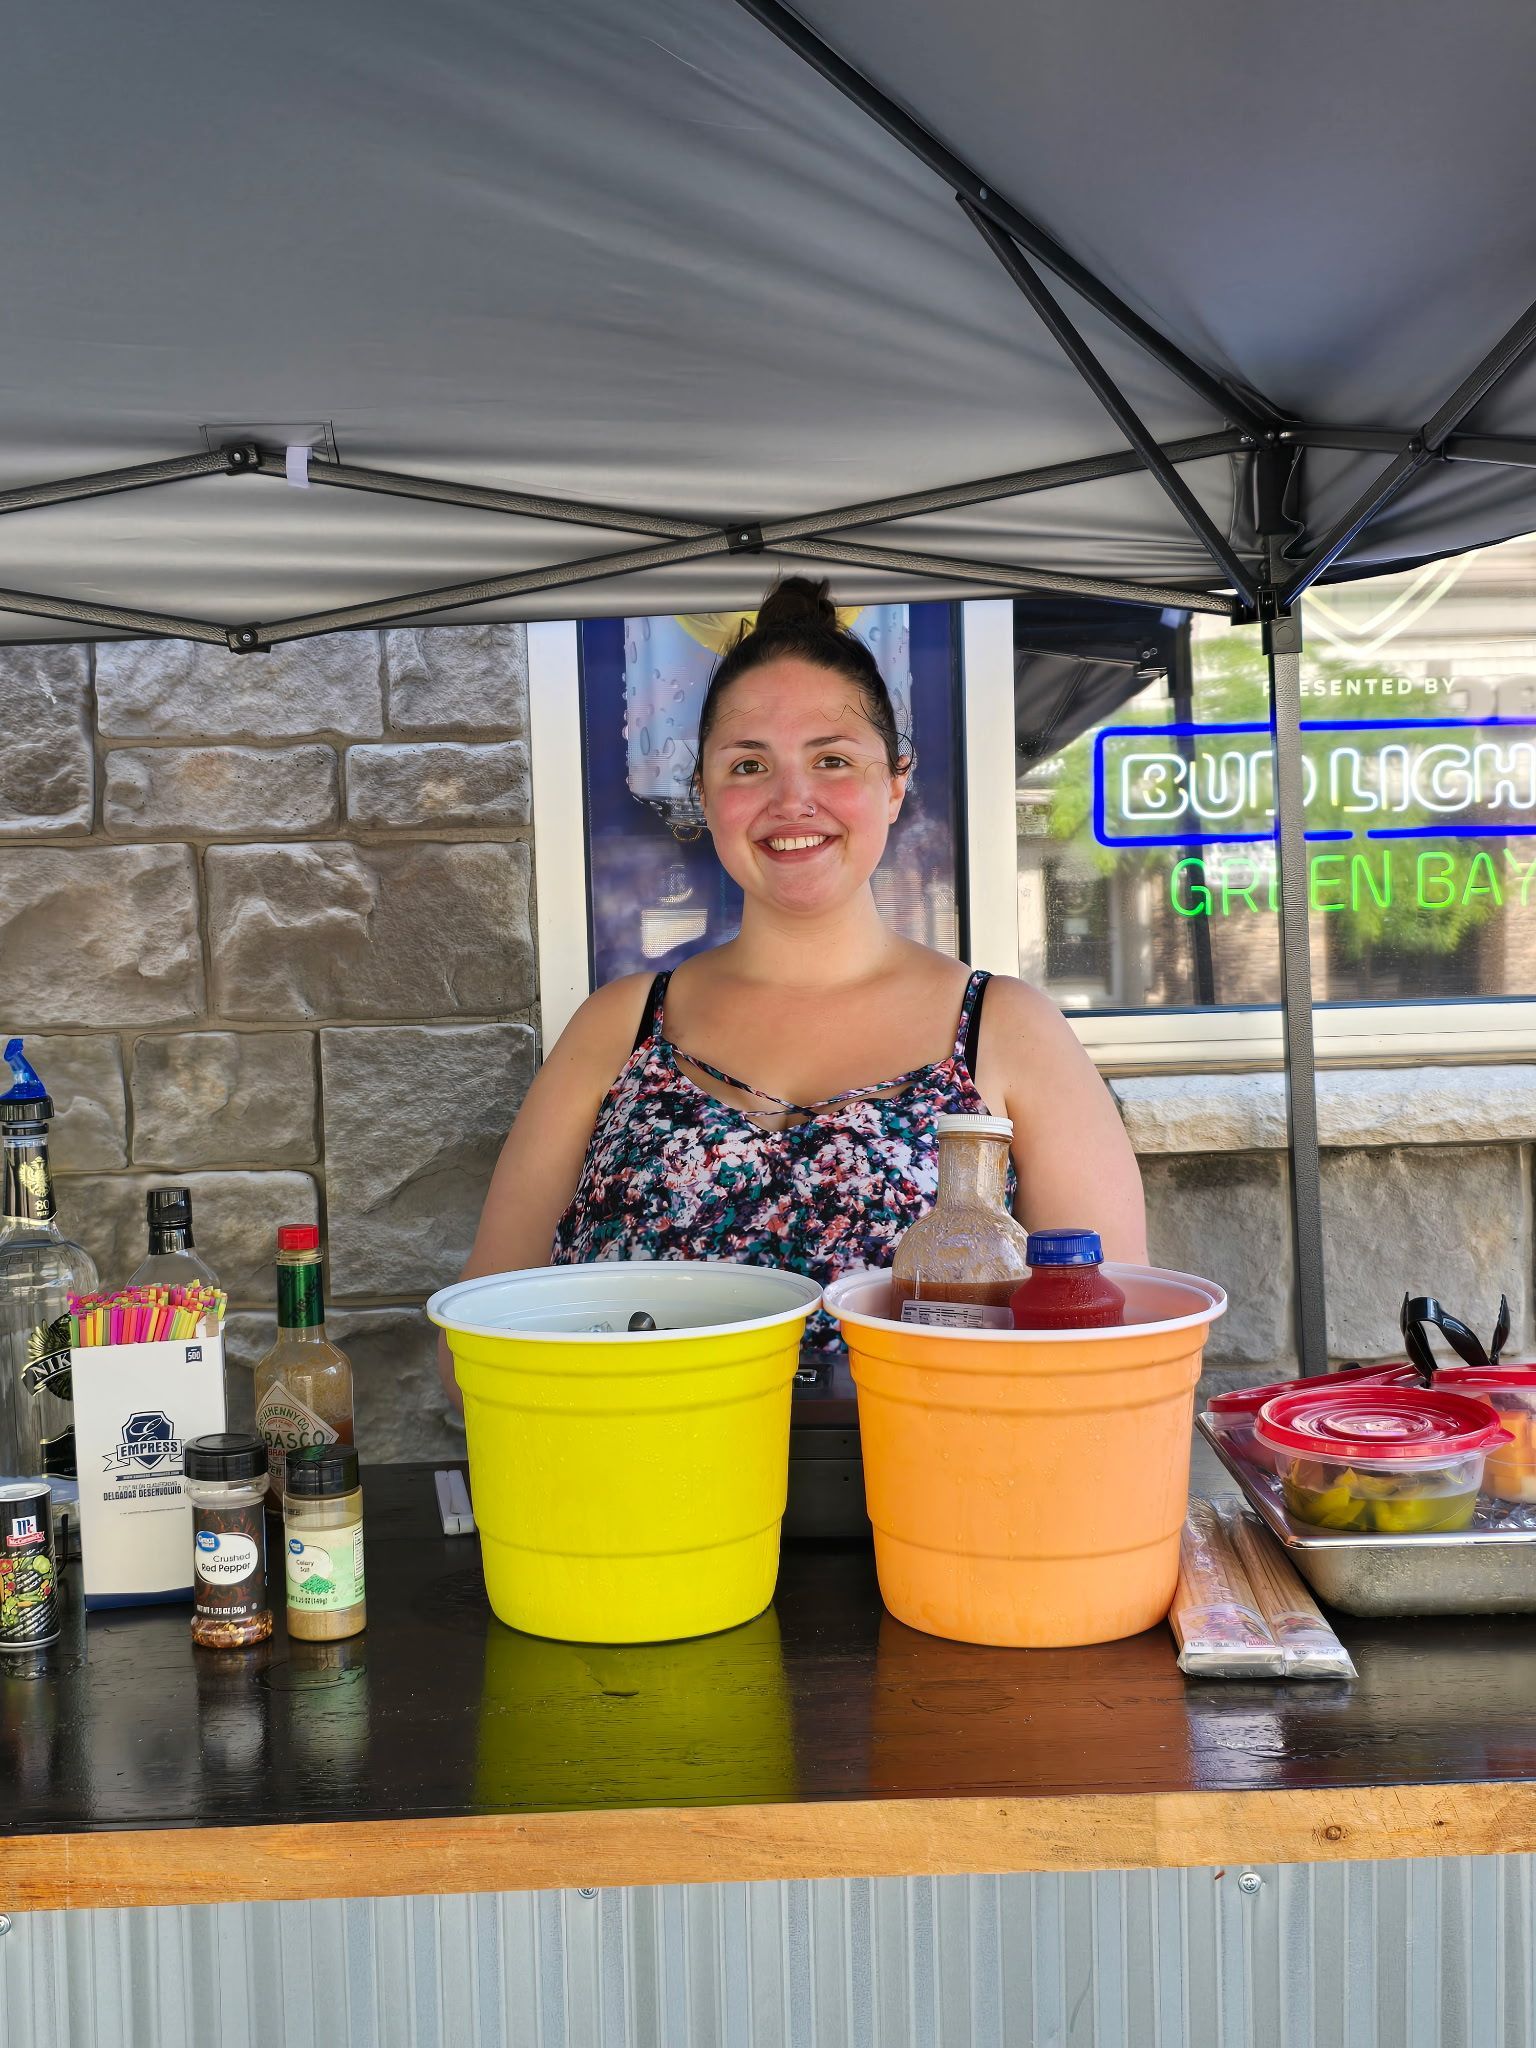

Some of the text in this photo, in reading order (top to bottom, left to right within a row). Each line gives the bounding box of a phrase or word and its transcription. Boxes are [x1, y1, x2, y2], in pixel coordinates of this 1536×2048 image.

[1262, 677, 1456, 697] PESENTED BY
[1417, 848, 1536, 909] BAY
[187, 1351, 201, 1361] 500
[30, 1351, 71, 1382] NIK
[256, 1428, 325, 1450] ABASCO
[121, 1441, 178, 1458] EMPRESS
[212, 1551, 251, 1563] Crushed
[201, 1562, 251, 1574] Red Pepper
